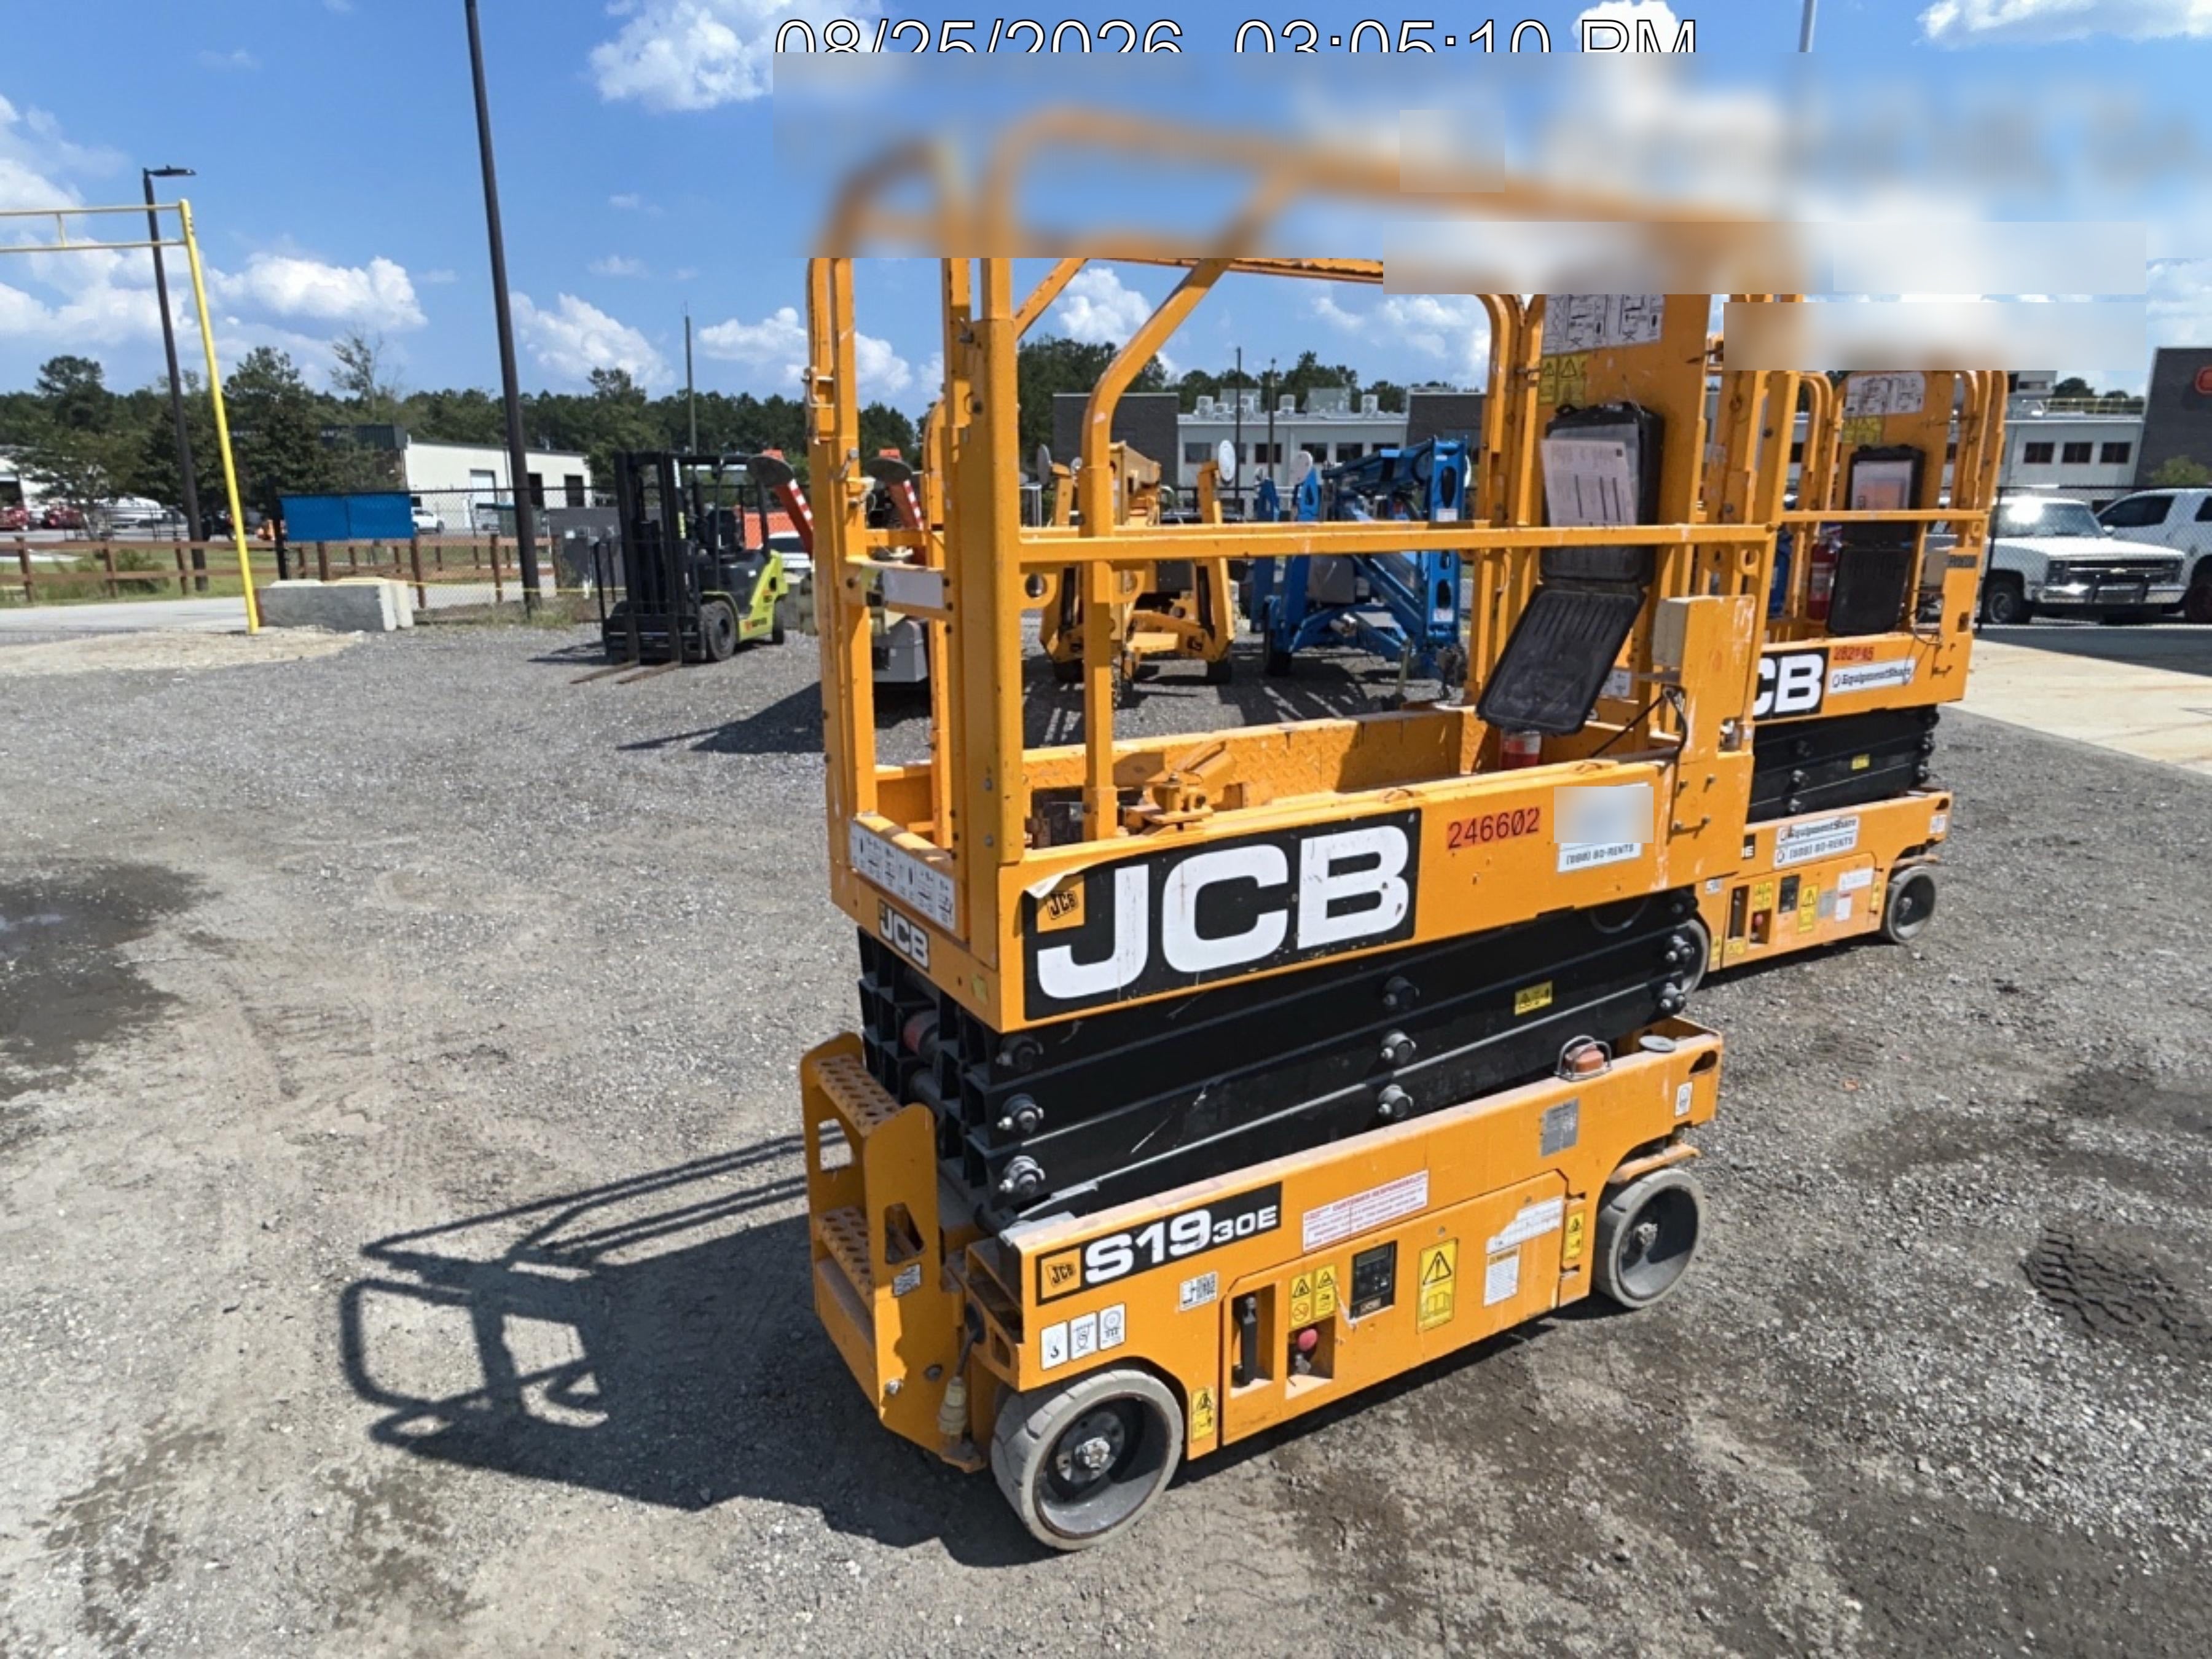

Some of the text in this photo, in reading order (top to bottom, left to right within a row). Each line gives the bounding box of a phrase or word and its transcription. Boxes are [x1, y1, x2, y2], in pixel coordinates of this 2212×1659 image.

[1448, 807, 1540, 849] 246602
[1037, 825, 1410, 1000] JCB
[1048, 890, 1078, 919] JCB
[880, 906, 929, 969] JCB
